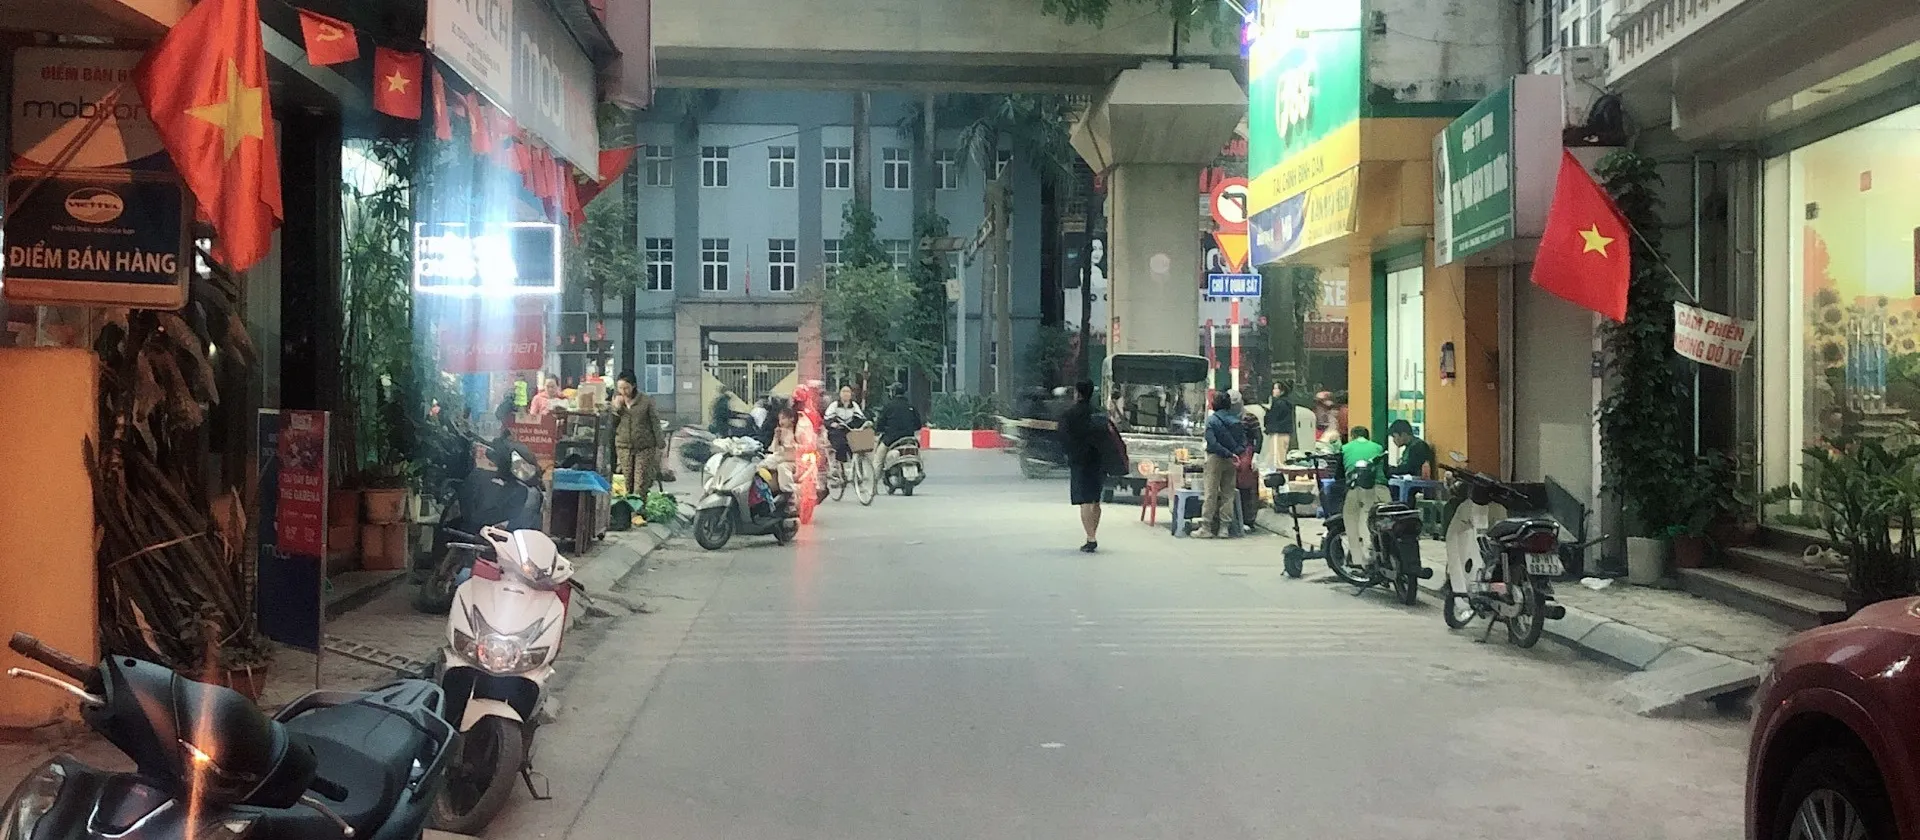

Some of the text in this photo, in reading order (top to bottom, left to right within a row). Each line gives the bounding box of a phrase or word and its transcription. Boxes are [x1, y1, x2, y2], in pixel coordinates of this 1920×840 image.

[9, 239, 176, 274] ĐIỂM BÁN HÀNG
